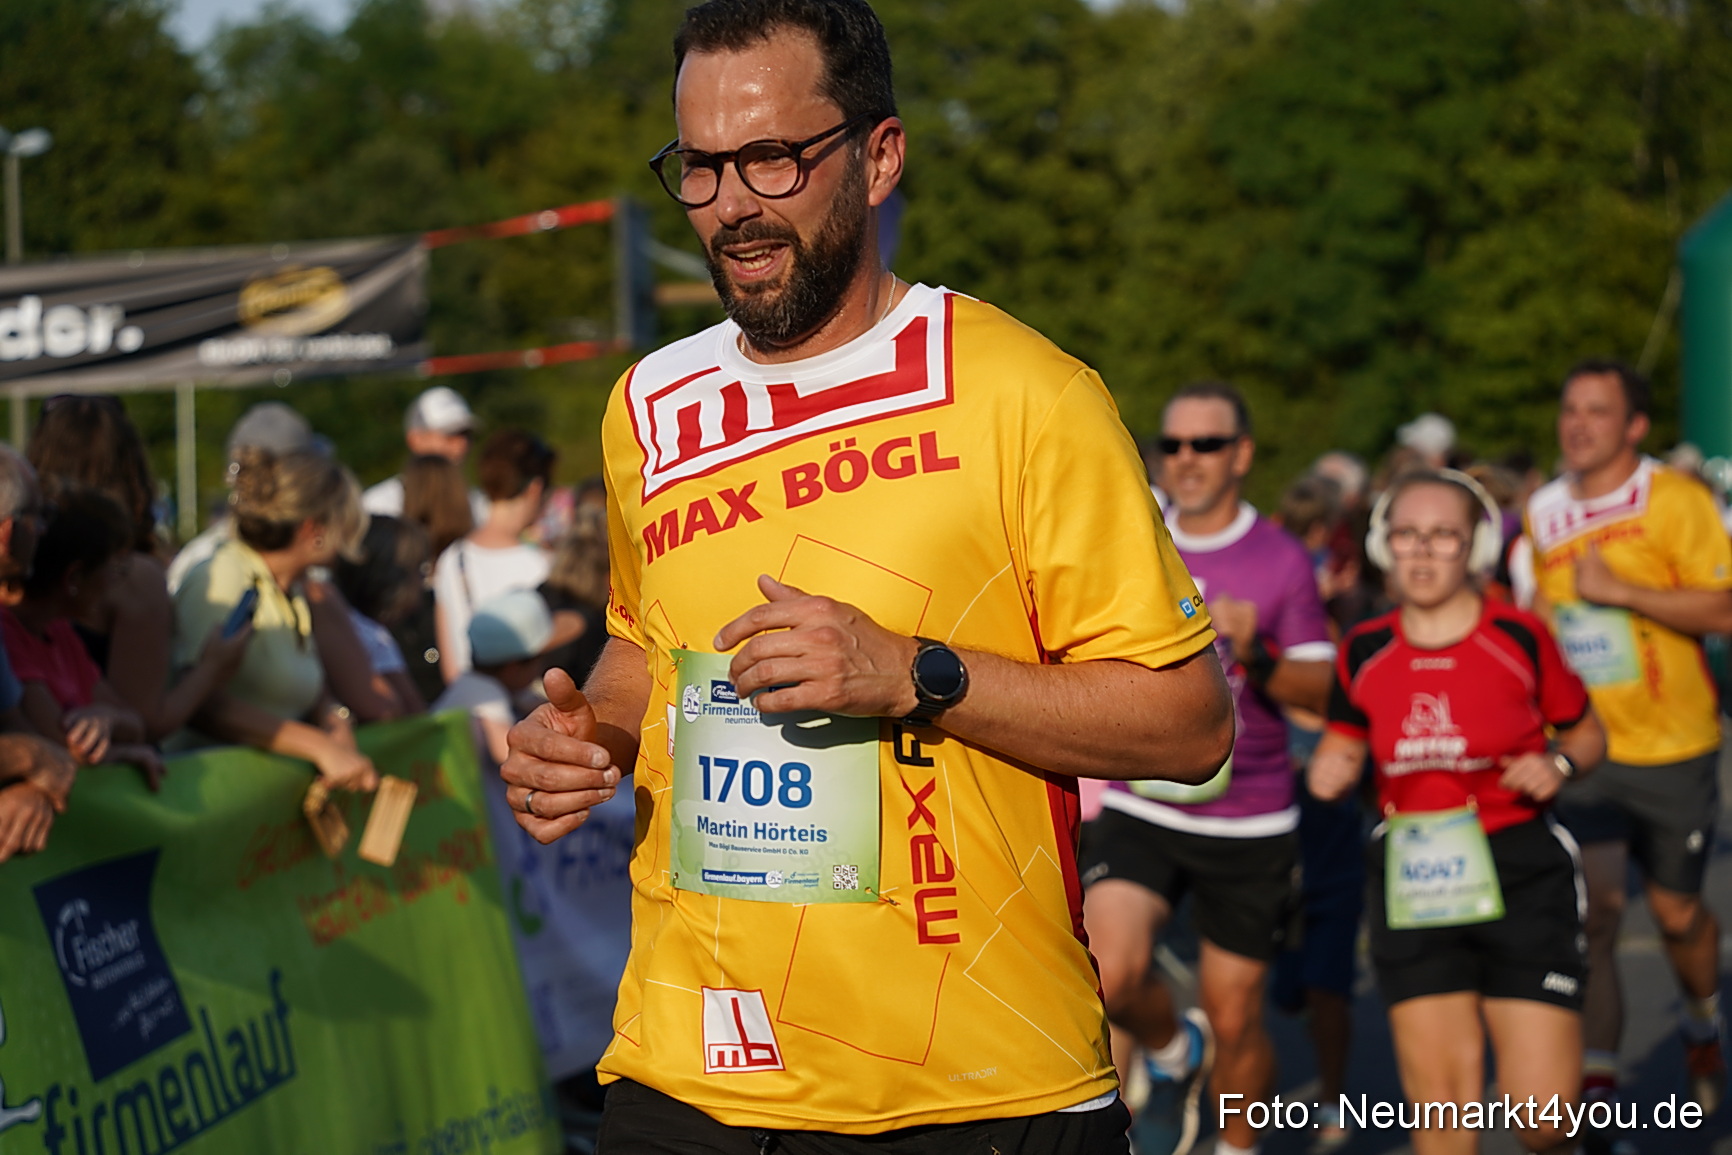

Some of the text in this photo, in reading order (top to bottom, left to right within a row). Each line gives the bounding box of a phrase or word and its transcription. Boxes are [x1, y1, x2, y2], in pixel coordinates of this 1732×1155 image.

[641, 430, 961, 566] MAX BÖGL
[702, 703, 761, 717] Firmenlau
[698, 755, 812, 809] 1708
[697, 815, 828, 843] Martin Hörteis
[731, 844, 761, 853] Bauservice
[43, 968, 297, 1155] firmenlauf
